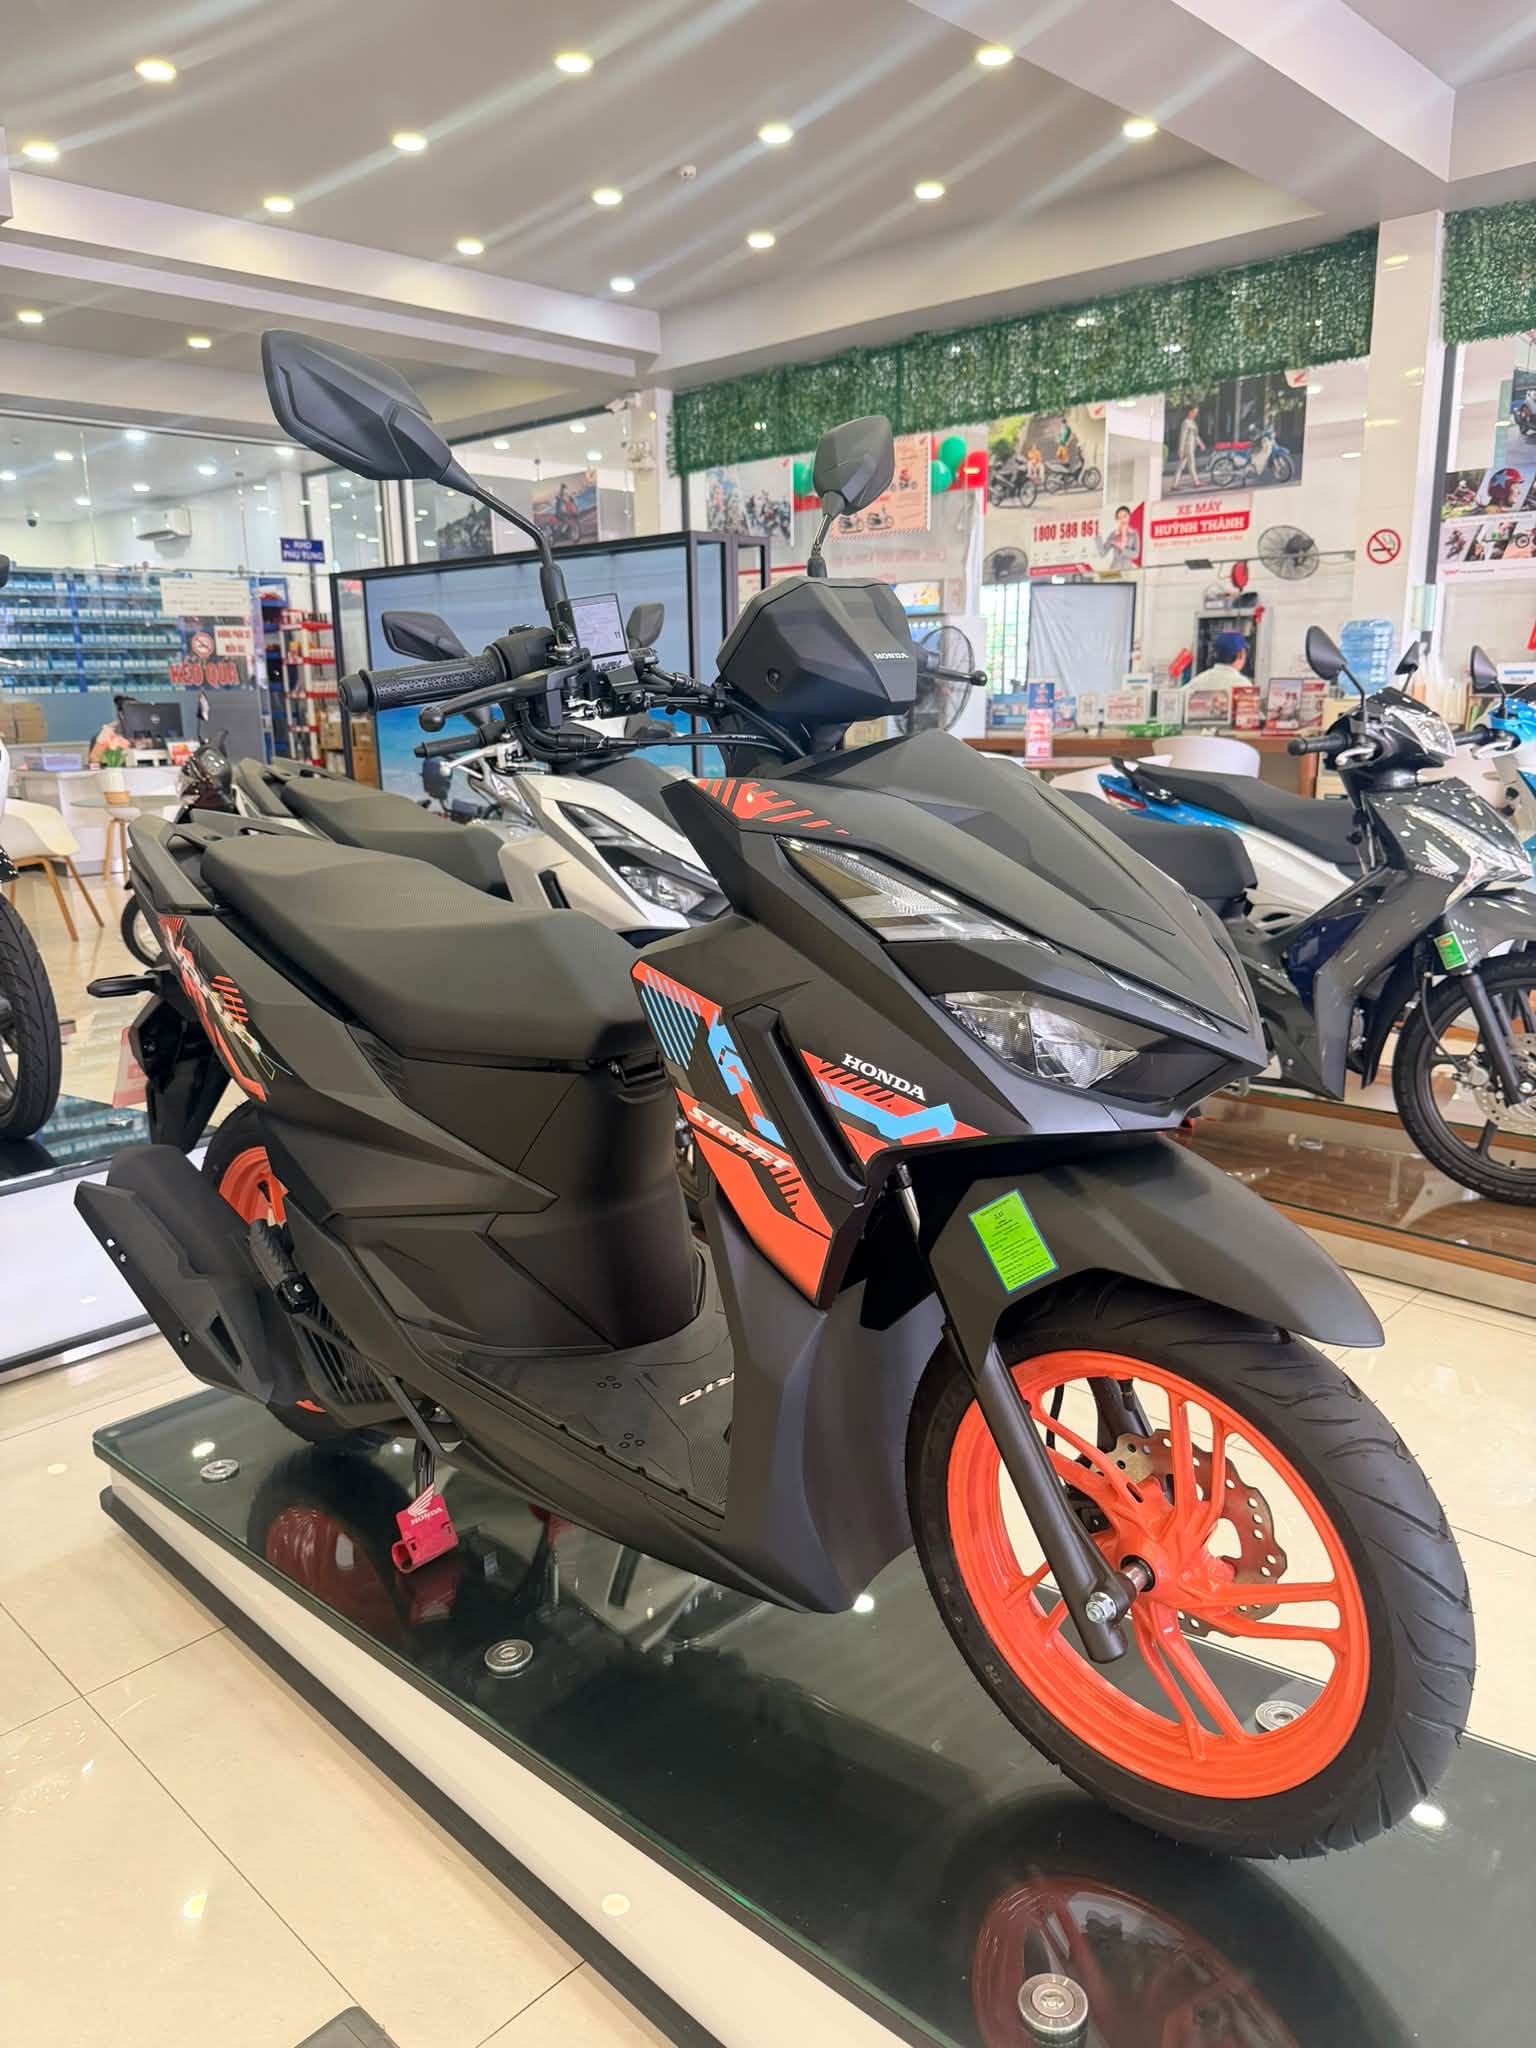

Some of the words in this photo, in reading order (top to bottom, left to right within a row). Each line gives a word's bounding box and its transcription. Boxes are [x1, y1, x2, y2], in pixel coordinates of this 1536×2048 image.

[1176, 504, 1192, 515] XE
[1033, 524, 1057, 542] 1800
[873, 652, 910, 660] HONDA
[1414, 863, 1454, 883] HONDA
[841, 1053, 927, 1102] HONDA
[687, 1106, 793, 1169] STREET
[410, 1506, 443, 1527] HONDA
